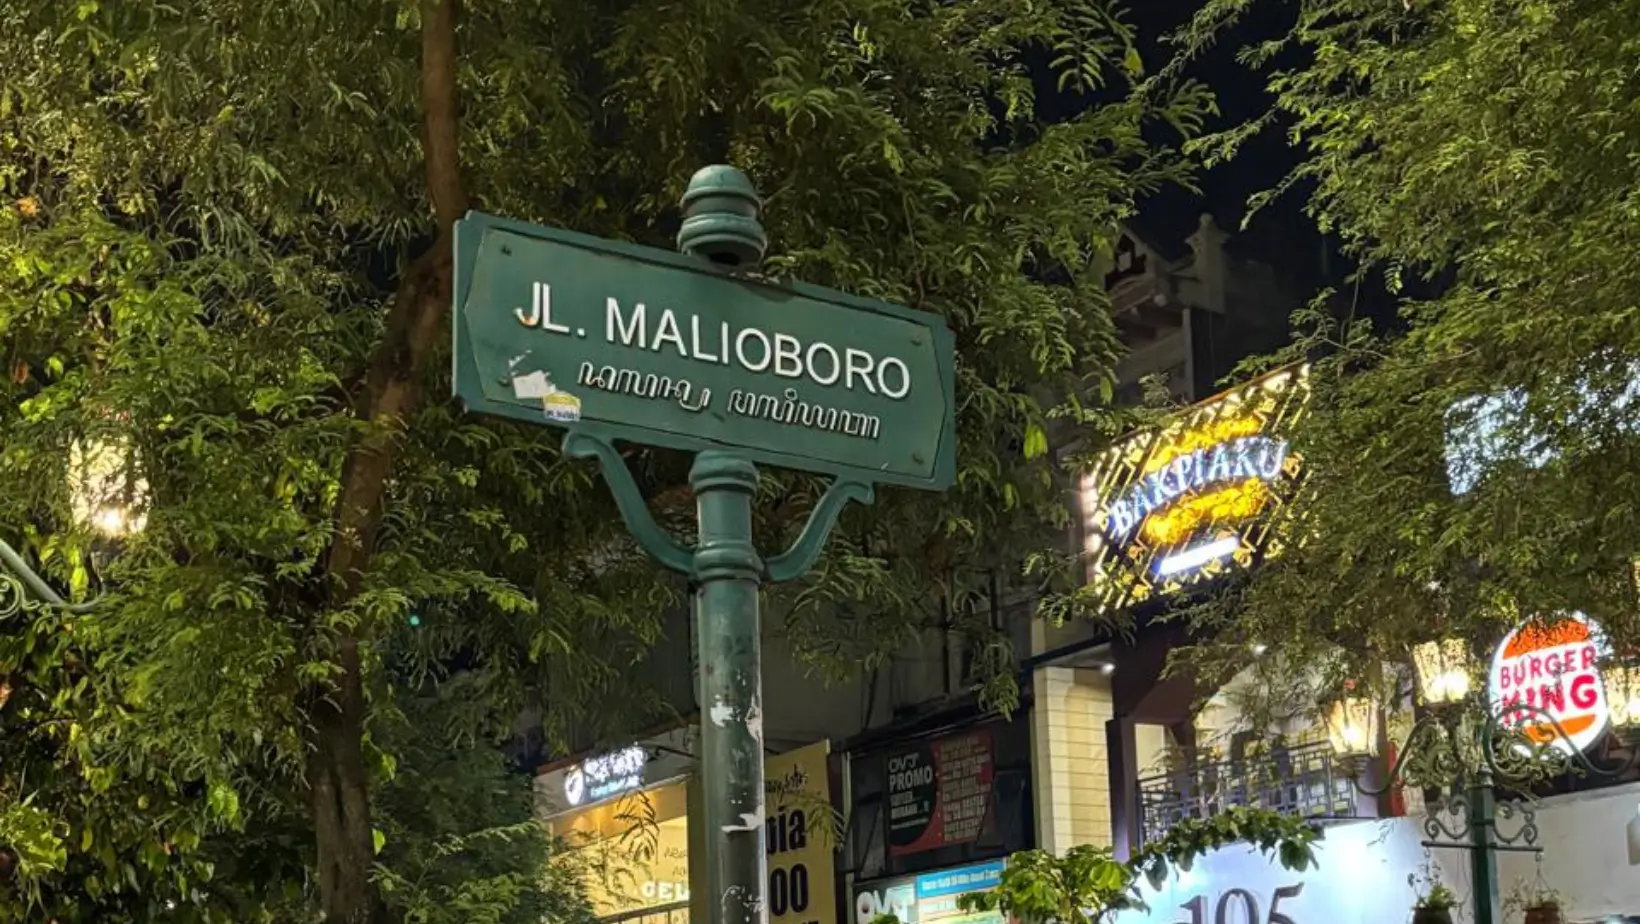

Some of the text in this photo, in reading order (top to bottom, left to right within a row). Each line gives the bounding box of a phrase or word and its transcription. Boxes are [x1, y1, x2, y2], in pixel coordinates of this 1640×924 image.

[513, 280, 910, 399] JL. MALIOBORO
[1109, 434, 1289, 537] BAKPIAKU
[1500, 645, 1596, 690] BURGER
[1502, 674, 1598, 726] KING
[889, 765, 933, 792] PROMO
